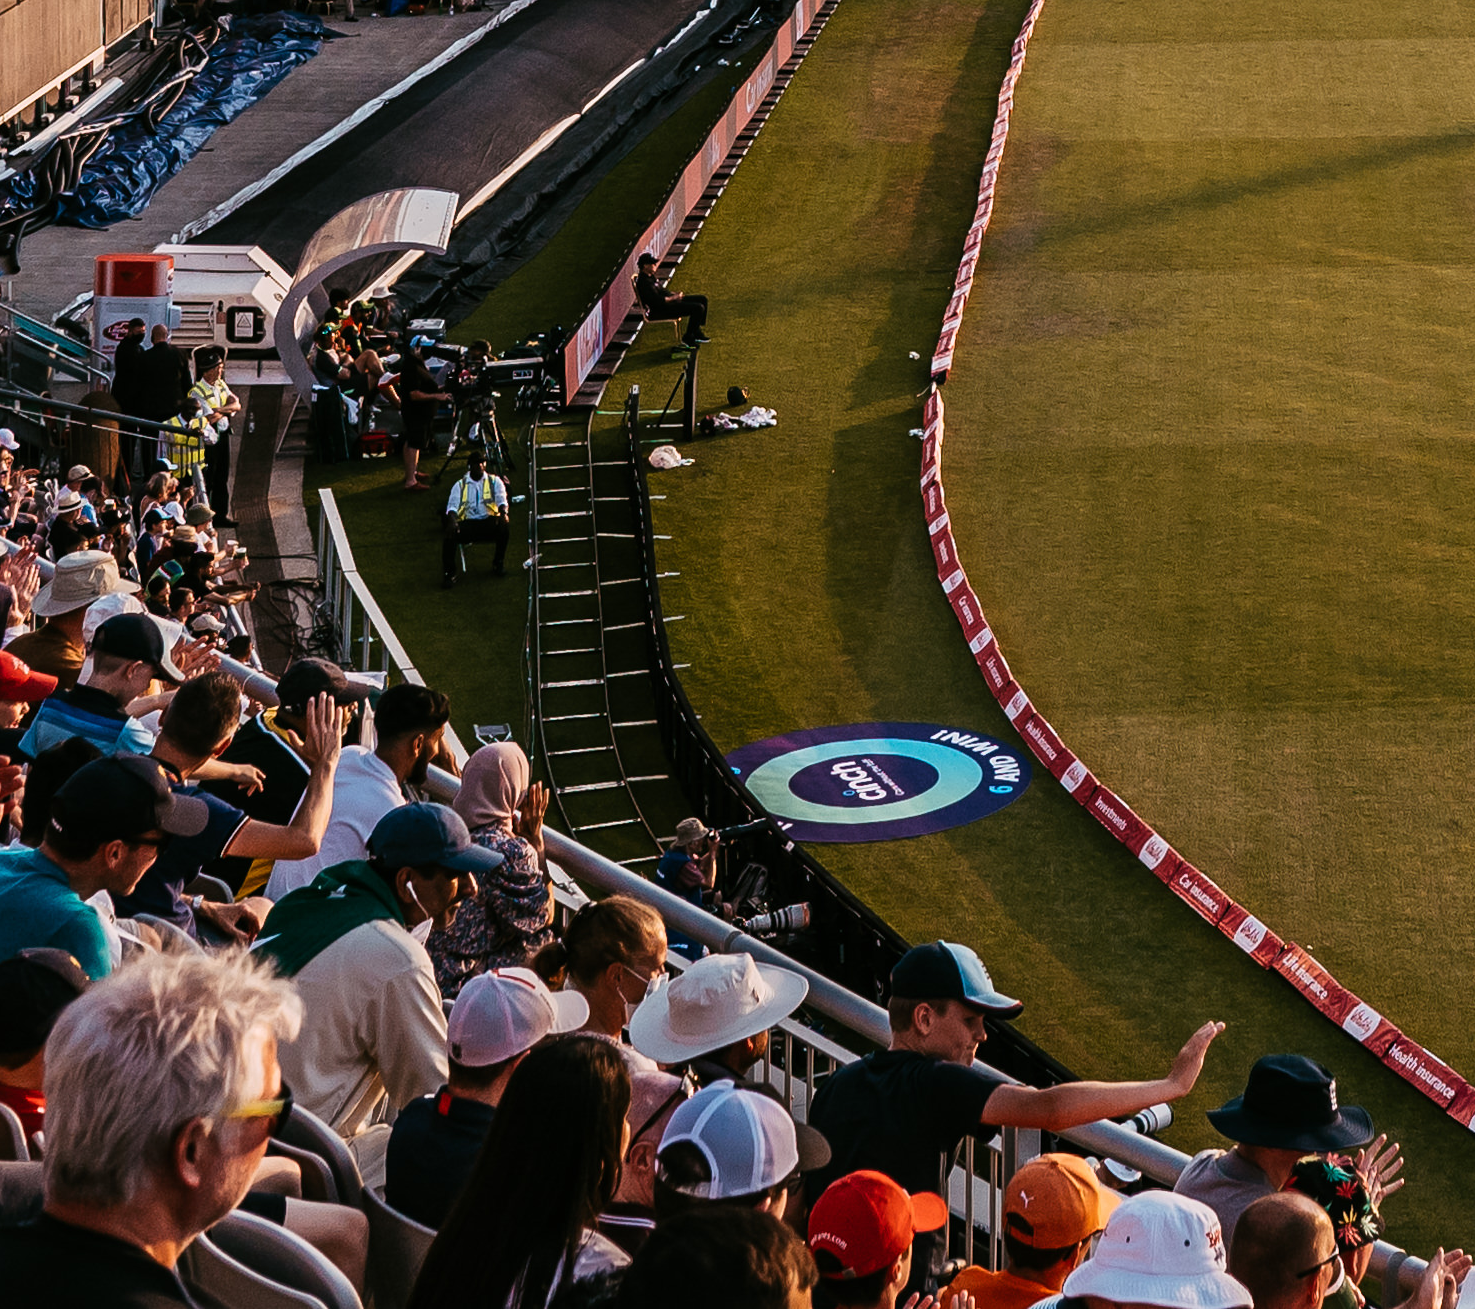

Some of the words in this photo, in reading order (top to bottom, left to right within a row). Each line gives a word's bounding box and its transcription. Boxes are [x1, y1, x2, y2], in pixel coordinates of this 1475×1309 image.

[988, 755, 1020, 783] AND
[1095, 795, 1128, 832] Investments
[1179, 873, 1195, 892] Car
[1190, 881, 1220, 915] insurance
[1282, 952, 1302, 976] Life
[1295, 964, 1328, 1001] insurance
[1388, 1043, 1420, 1074] Health
[1414, 1060, 1456, 1102] insurance
